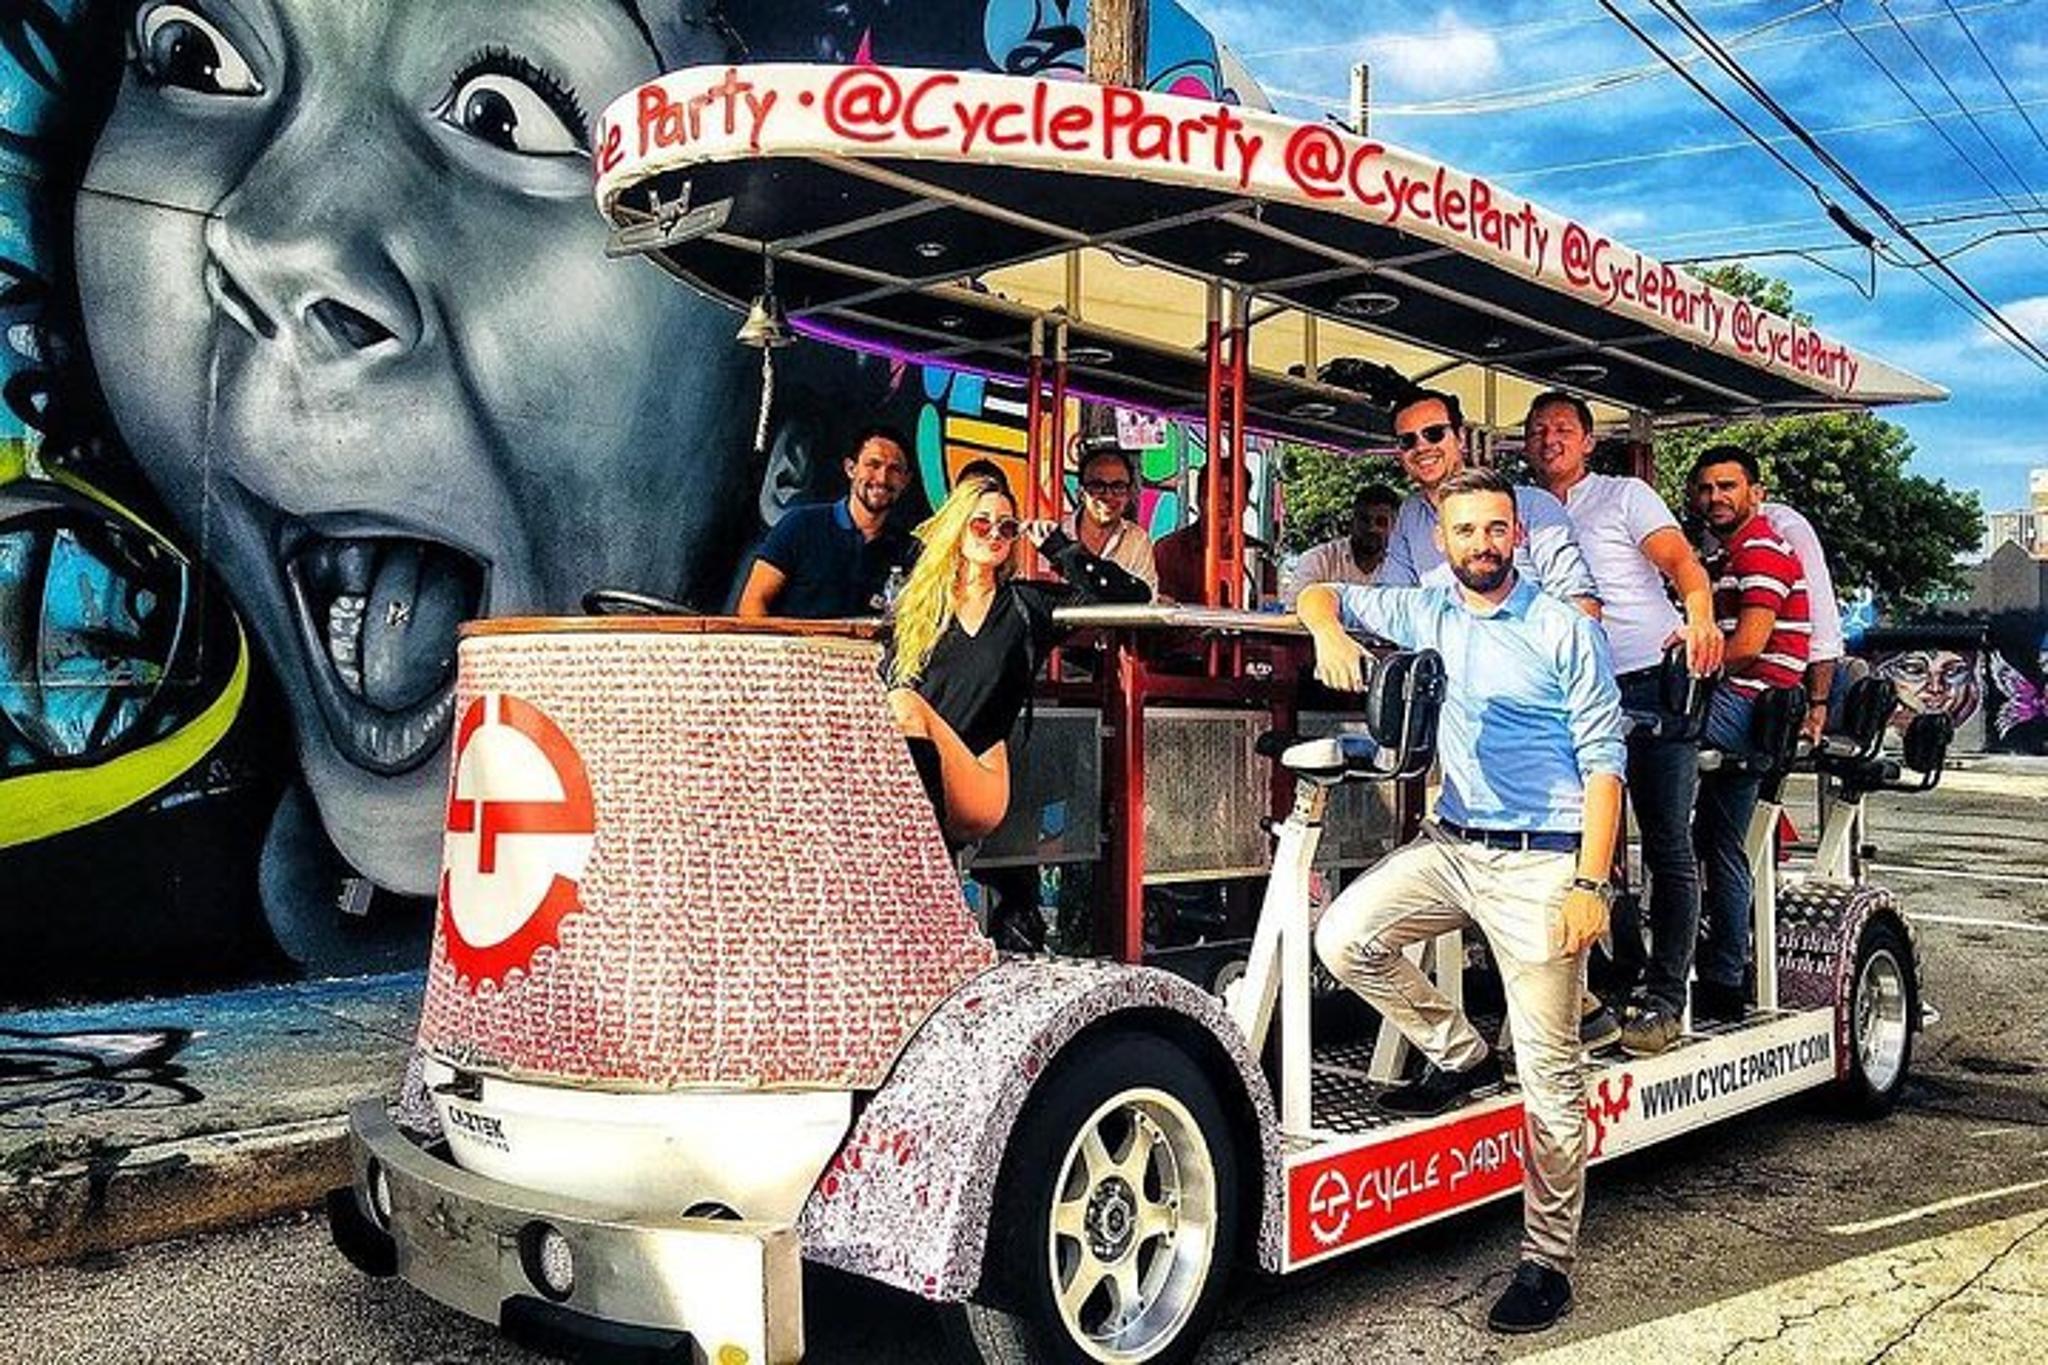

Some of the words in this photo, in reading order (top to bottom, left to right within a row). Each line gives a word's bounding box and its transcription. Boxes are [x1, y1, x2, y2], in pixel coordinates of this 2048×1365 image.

[636, 67, 777, 157] Party
[822, 66, 1264, 189] @CycleParty
[1284, 124, 1549, 276] @CycleParty
[1561, 222, 1724, 347] @CycleParty
[1731, 300, 1859, 394] @CycleParty
[1640, 1032, 1831, 1119] WWW.CYCLEPARTY.COM
[1356, 1153, 1441, 1214] CYCLE
[1450, 1127, 1524, 1191] PARTY
